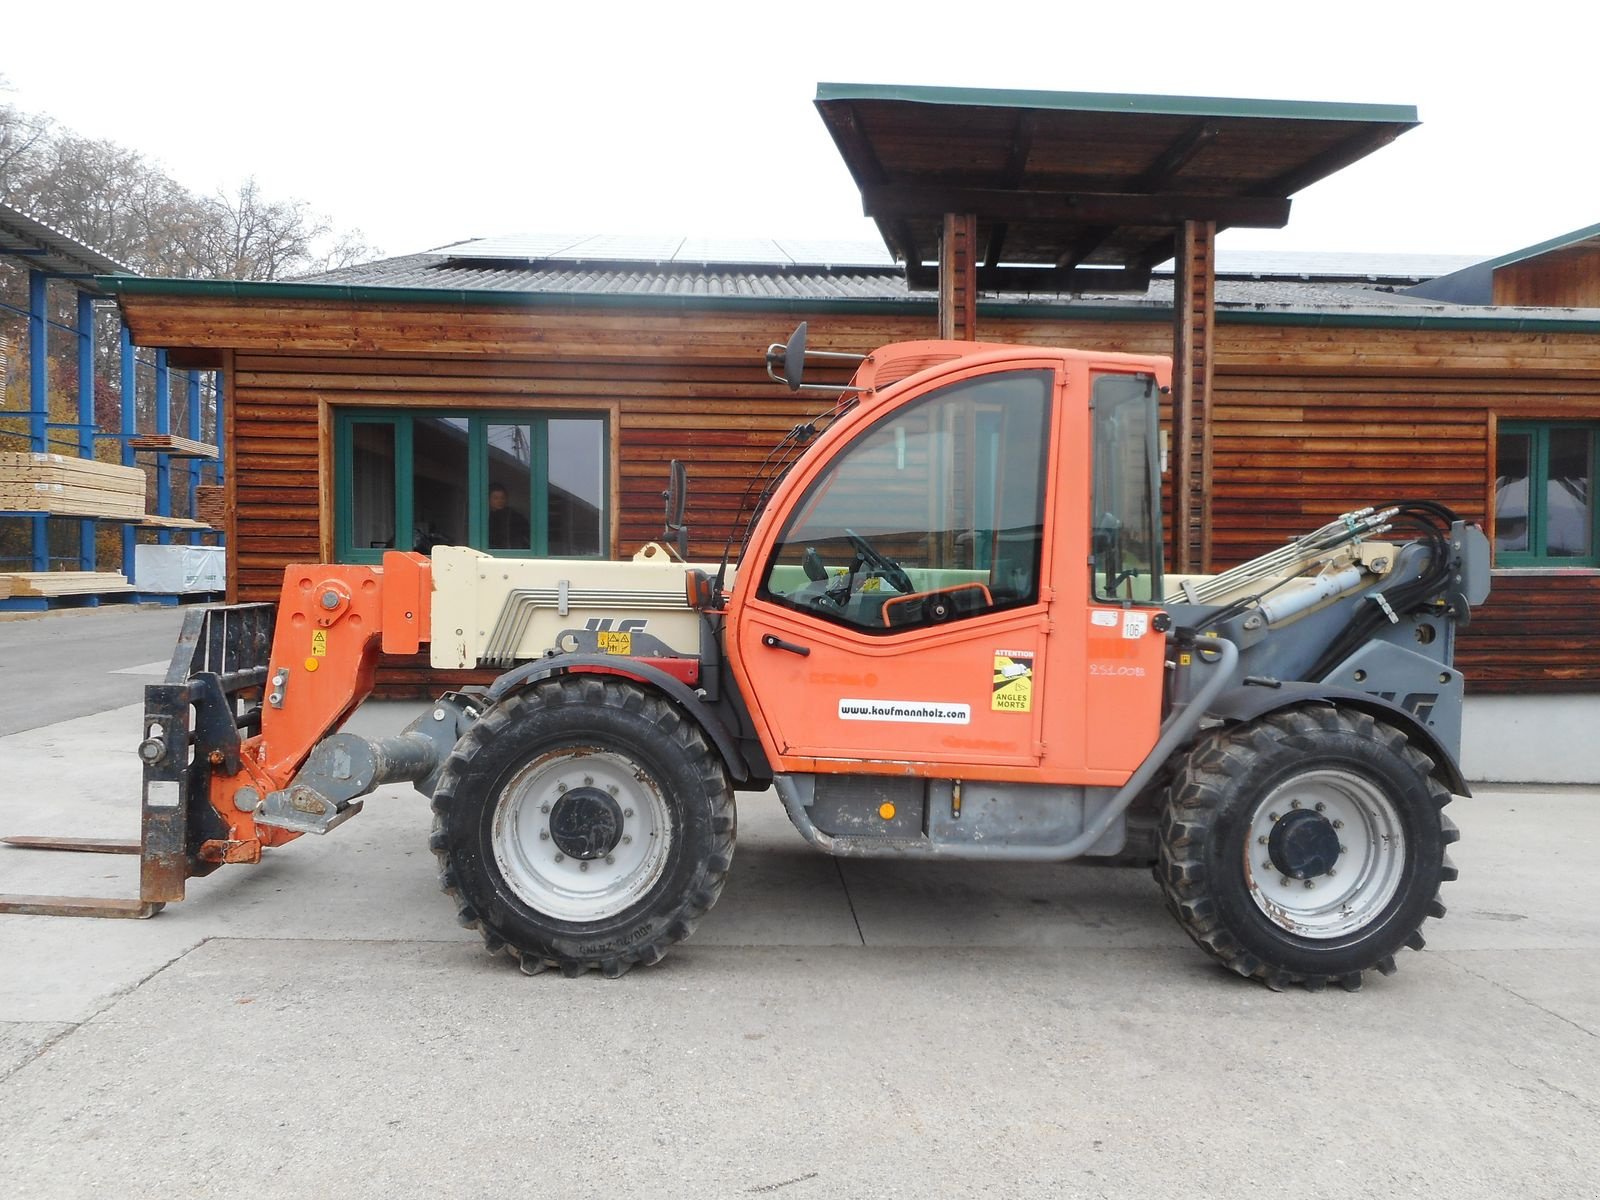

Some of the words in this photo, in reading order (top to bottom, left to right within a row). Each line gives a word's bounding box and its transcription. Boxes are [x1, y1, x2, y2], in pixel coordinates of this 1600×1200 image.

[1126, 623, 1140, 637] 106
[994, 649, 1034, 658] ATTENTION
[996, 693, 1027, 702] ANGLES
[997, 700, 1025, 709] MORTS
[841, 705, 966, 719] www.kaufmannholz.com
